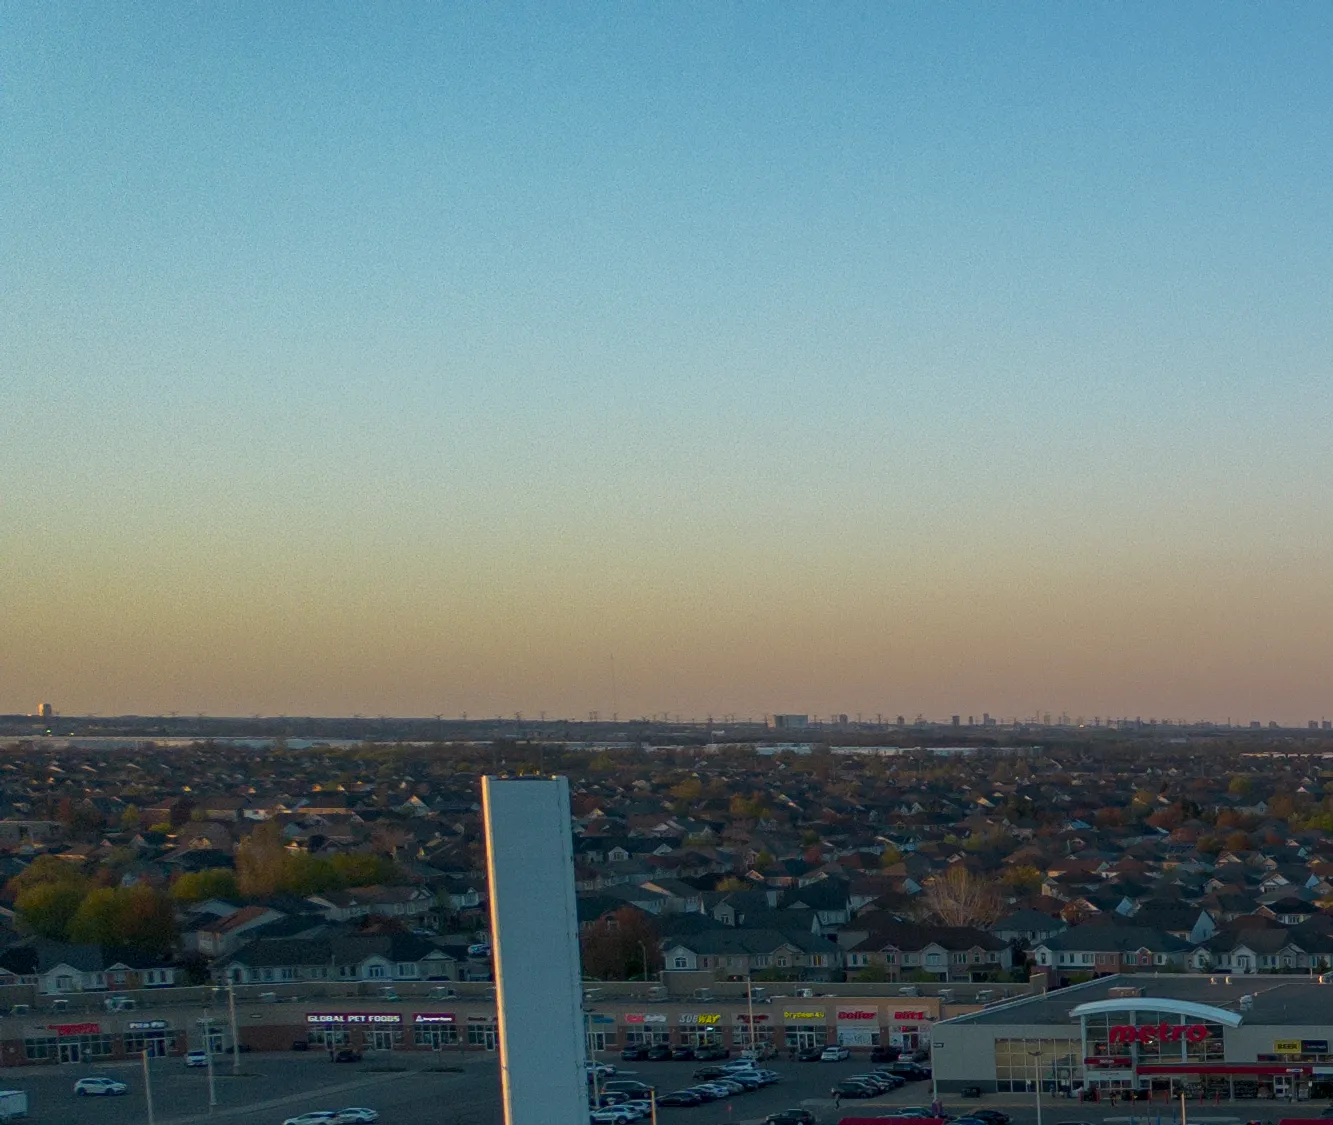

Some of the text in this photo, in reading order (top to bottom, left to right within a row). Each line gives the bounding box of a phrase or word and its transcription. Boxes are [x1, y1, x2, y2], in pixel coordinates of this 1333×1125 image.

[307, 1015, 400, 1023] GLOBAL PET FOODS
[680, 1014, 720, 1025] SUBWAY
[1109, 1022, 1208, 1044] metro
